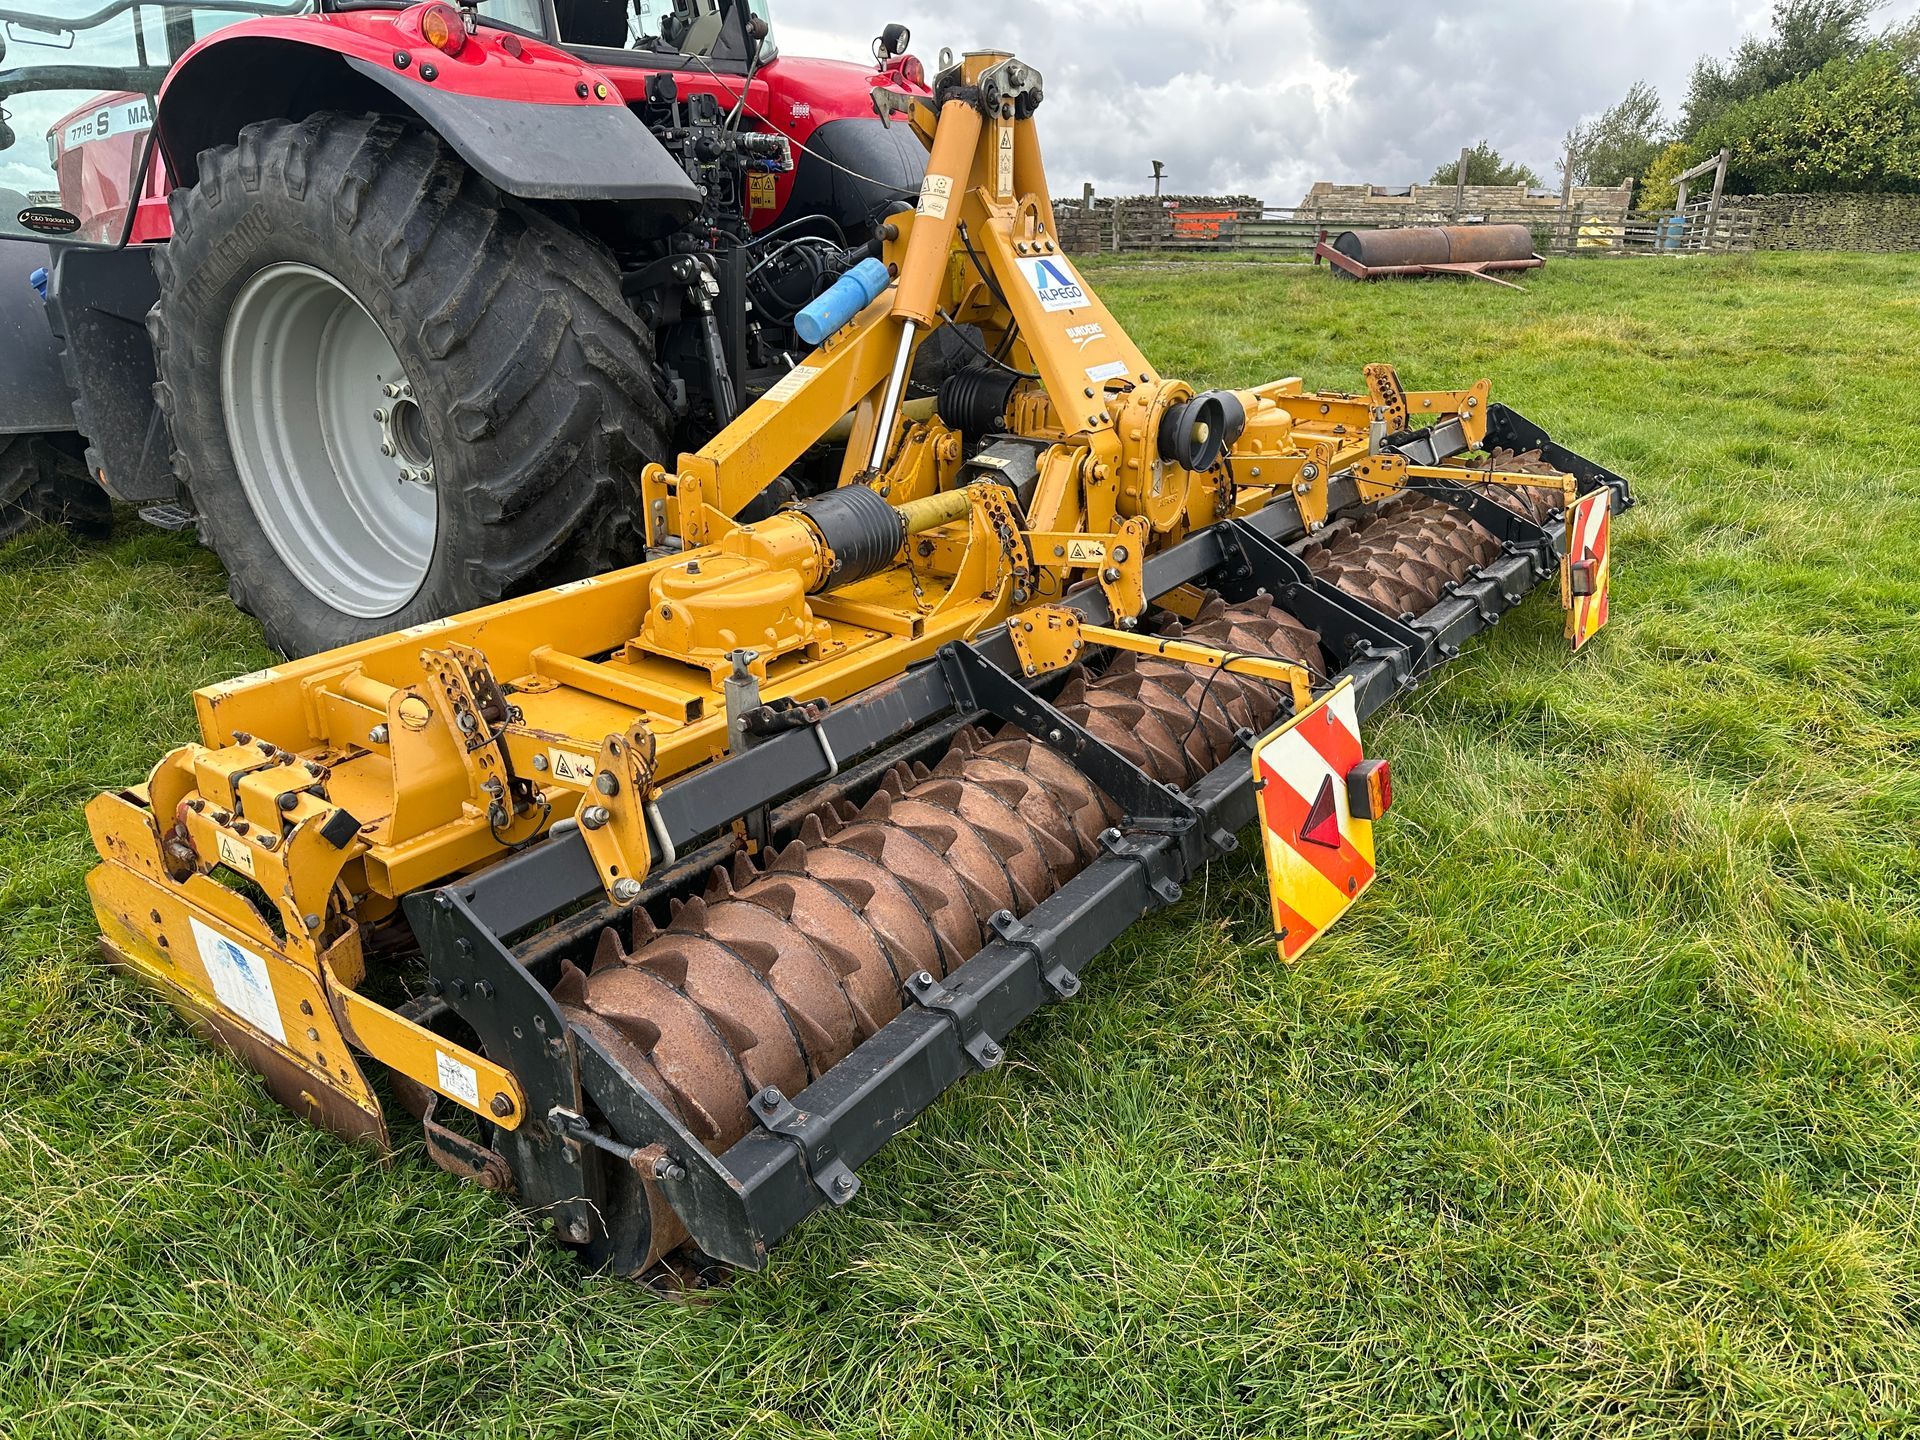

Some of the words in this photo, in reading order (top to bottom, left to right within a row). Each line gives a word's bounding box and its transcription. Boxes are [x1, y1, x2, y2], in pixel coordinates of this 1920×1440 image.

[71, 122, 93, 140] 7719
[96, 111, 109, 135] S
[1038, 285, 1082, 302] ALPEGO
[1065, 322, 1103, 338] BURDENS
